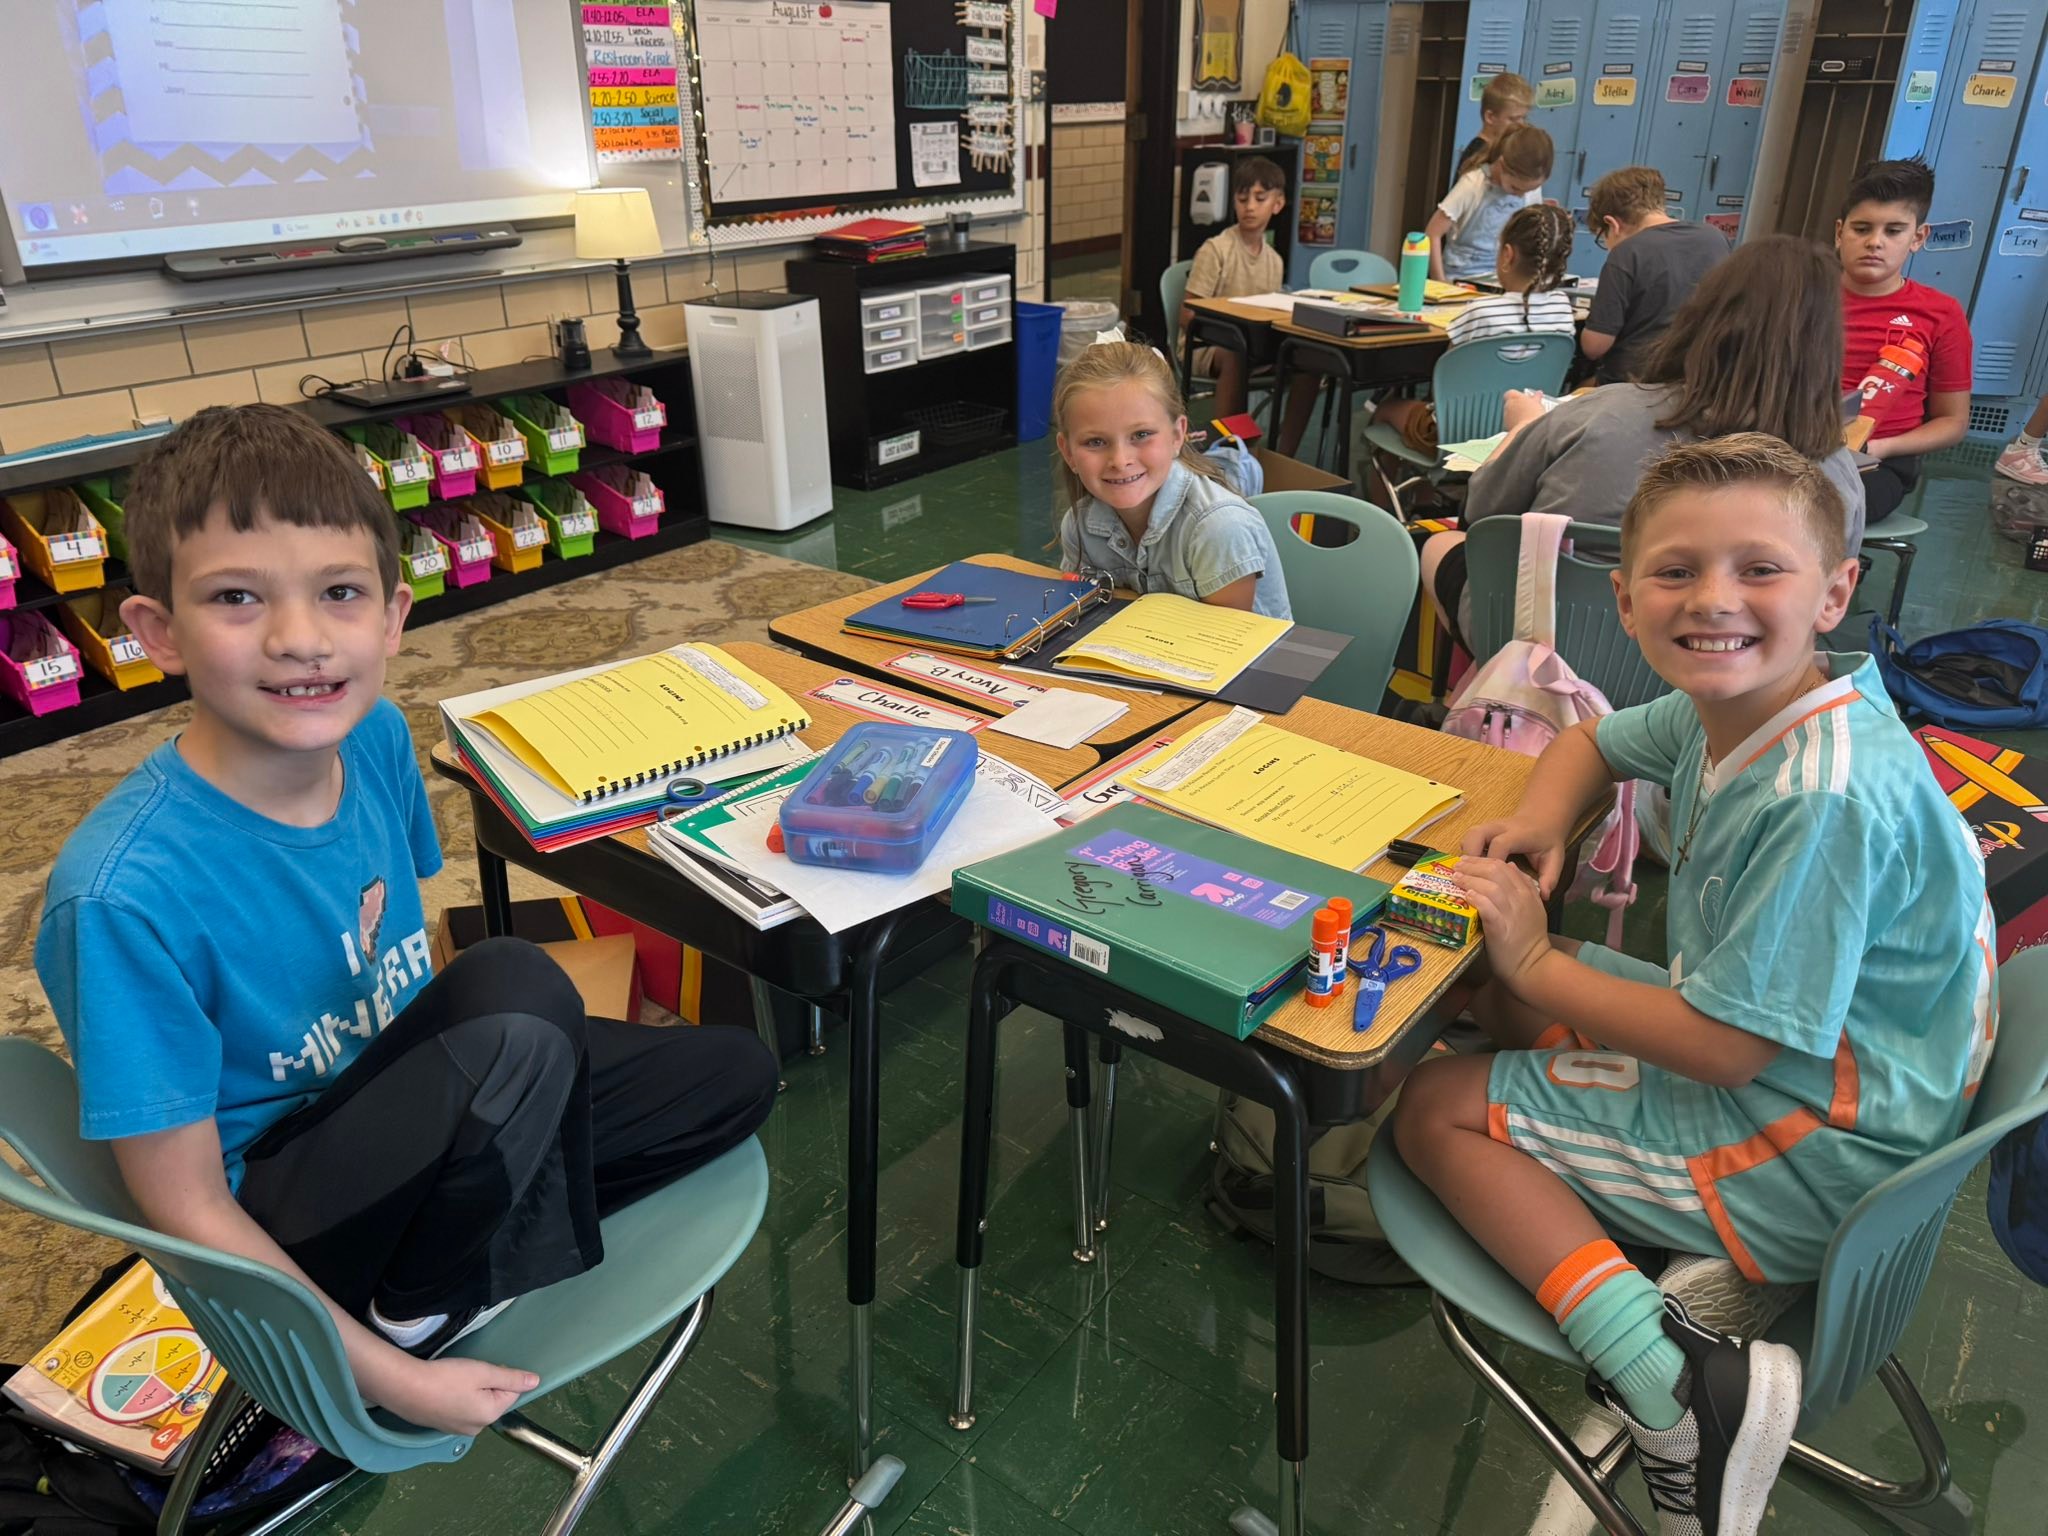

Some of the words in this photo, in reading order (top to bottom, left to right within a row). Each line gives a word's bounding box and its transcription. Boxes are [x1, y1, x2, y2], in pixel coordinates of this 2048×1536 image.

[636, 7, 655, 17] ELA
[772, 1, 815, 24] August
[593, 50, 641, 66] Restroom
[642, 69, 660, 78] ELA
[1602, 85, 1628, 98] Stella
[1972, 84, 2006, 97] Charlie
[1933, 232, 1956, 242] Avery
[2014, 235, 2038, 248] Izzy
[642, 414, 654, 424] 12
[558, 435, 567, 445] 11
[496, 444, 511, 456] 10
[453, 455, 464, 468] 9
[405, 464, 416, 479] 8
[638, 501, 653, 513] 24
[568, 518, 587, 532] 23
[520, 531, 537, 545] 22
[67, 541, 82, 555] 4
[466, 544, 481, 559] 21
[420, 557, 438, 570] 20
[124, 646, 142, 659] 16
[40, 662, 61, 676] 15
[952, 670, 1009, 695] Avery
[659, 683, 686, 702] LOGINS
[808, 689, 834, 702] Tues
[857, 691, 933, 719] Charlie
[965, 715, 984, 724] 17
[1253, 757, 1281, 775] LOGINS
[1094, 840, 1150, 864] D-Ring
[1056, 861, 1125, 914] Gregory
[1406, 889, 1464, 910] Crayola
[340, 931, 361, 976] I
